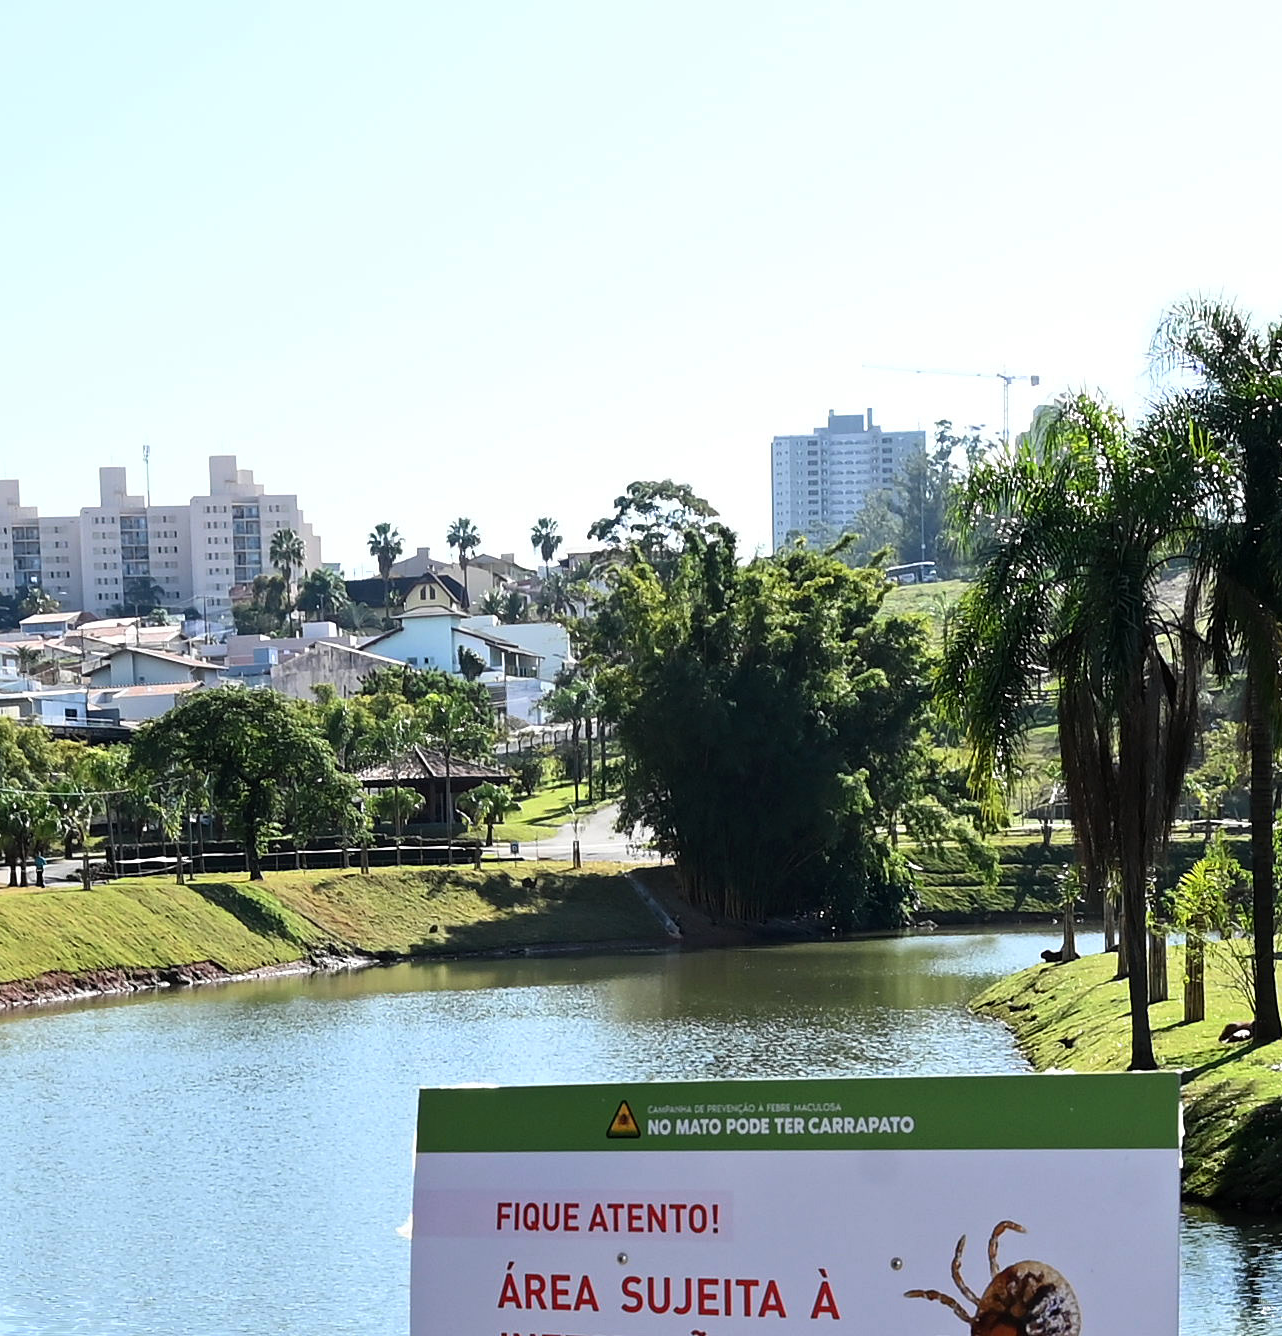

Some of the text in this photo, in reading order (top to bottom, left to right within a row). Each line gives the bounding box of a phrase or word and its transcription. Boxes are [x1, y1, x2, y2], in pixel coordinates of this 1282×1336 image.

[647, 1102, 842, 1115] CAMPANHA DE PREVENÇÃO À FEBRE MACULOSA
[647, 1116, 915, 1136] NO MATO PODE TER CARRAPATO
[495, 1203, 720, 1234] FIQUE ATENTO!
[498, 1261, 840, 1320] ÁREA SUJEITA À
